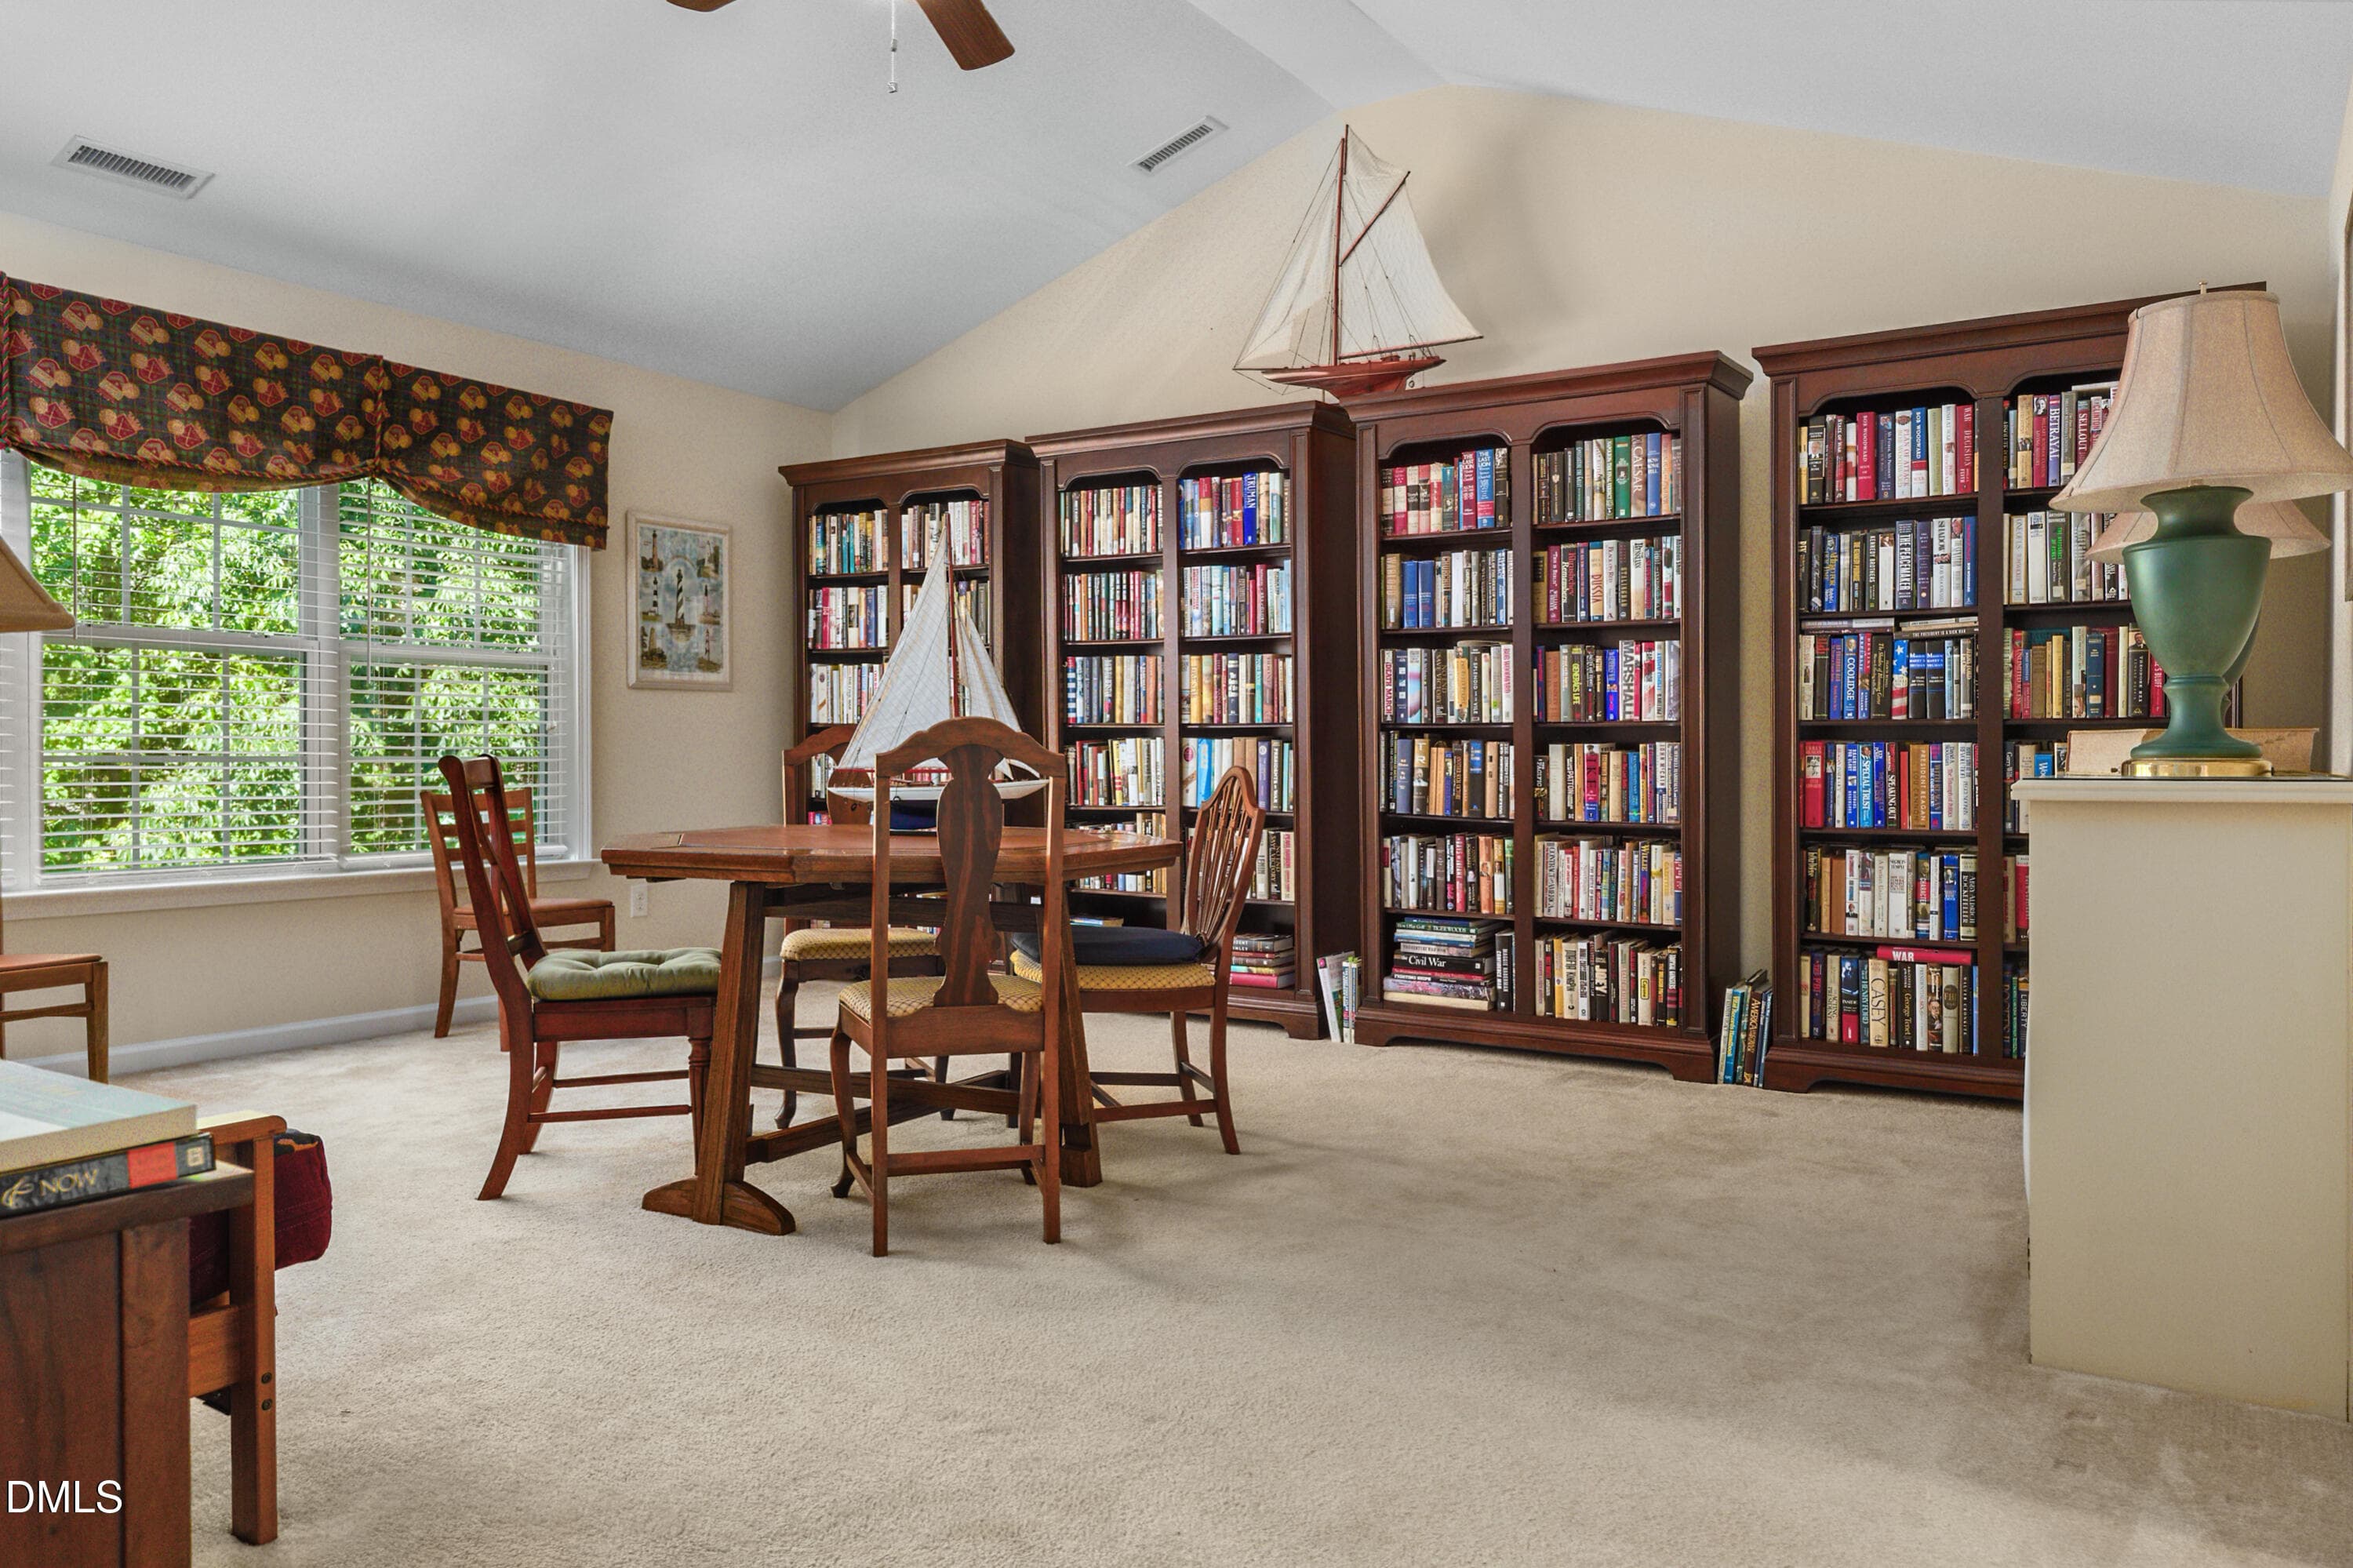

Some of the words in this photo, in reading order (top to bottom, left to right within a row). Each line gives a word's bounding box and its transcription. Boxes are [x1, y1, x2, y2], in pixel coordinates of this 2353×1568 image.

[1964, 408, 1973, 422] WAR
[2093, 405, 2101, 430] CLINTON
[2049, 408, 2060, 461] BETRAYAL
[2078, 413, 2087, 451] SELLOUT
[1964, 430, 1973, 466] DECISION
[1633, 446, 1644, 494] CAESAR
[1900, 534, 1911, 546] THE
[1900, 548, 1911, 591] PEACEMAKER
[1384, 662, 1393, 687] DEATH
[1623, 640, 1635, 720] MARSHALL
[1846, 657, 1855, 700] COOLIDGE
[1384, 688, 1393, 714] MARCH
[1572, 693, 1580, 705] LIFE
[1417, 755, 1426, 764] R
[1586, 759, 1596, 788] IKE
[1862, 760, 1871, 788] SPECIAL
[1862, 790, 1871, 810] TRUST
[1641, 844, 1649, 871] WILLIE
[1409, 955, 1426, 965] Civil
[1428, 957, 1446, 967] War
[1566, 950, 1577, 970] MAFIA
[1892, 951, 1915, 962] WAR
[1566, 971, 1577, 991] KINGPIN
[1595, 965, 1607, 993] JOEY
[1749, 998, 1762, 1030] AMERICA
[1871, 977, 1886, 1026] CASEY
[1903, 993, 1912, 1017] George
[1903, 1017, 1912, 1035] Tenet
[40, 1169, 97, 1199] NOW
